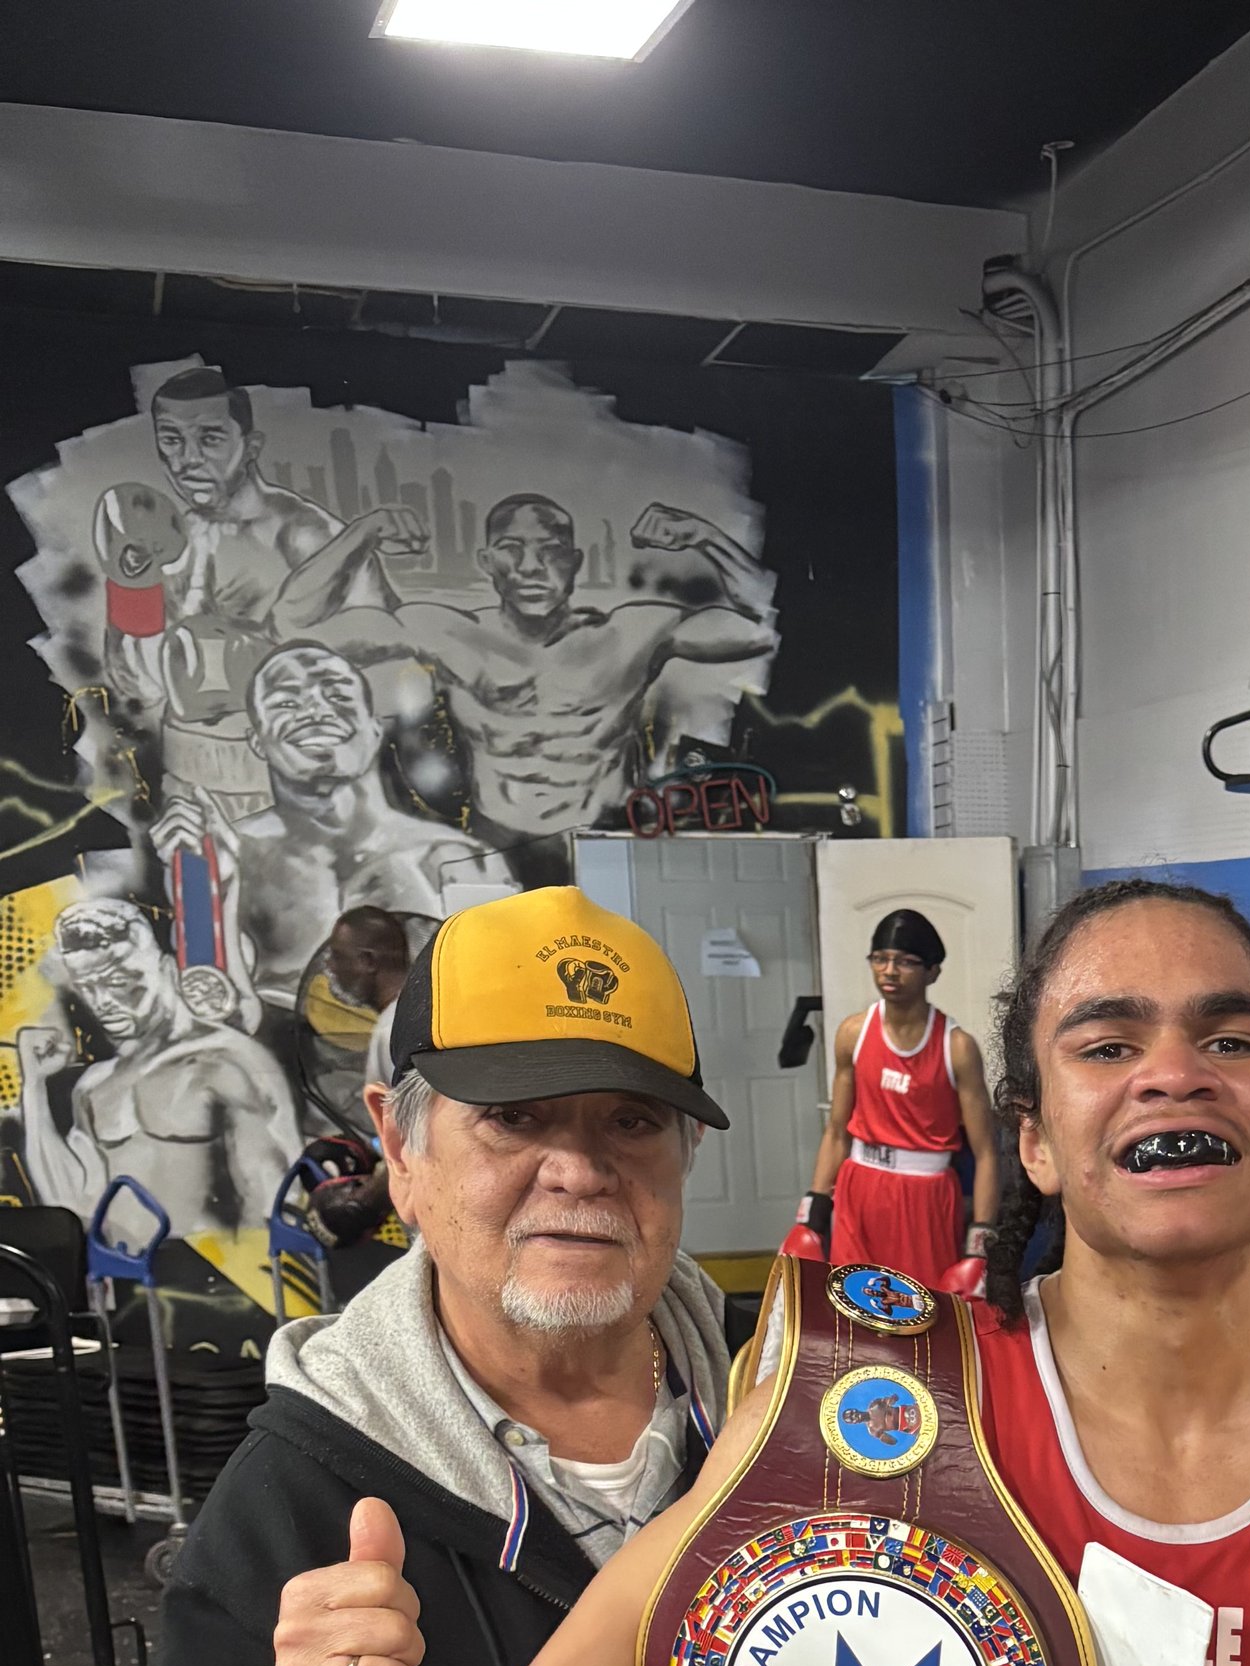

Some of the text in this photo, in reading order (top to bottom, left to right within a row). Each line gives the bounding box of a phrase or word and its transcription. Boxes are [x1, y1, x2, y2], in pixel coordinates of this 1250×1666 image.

[626, 774, 770, 840] OPEN
[536, 934, 630, 973] EL MAESTRO
[546, 1004, 633, 1029] BOXING GYM
